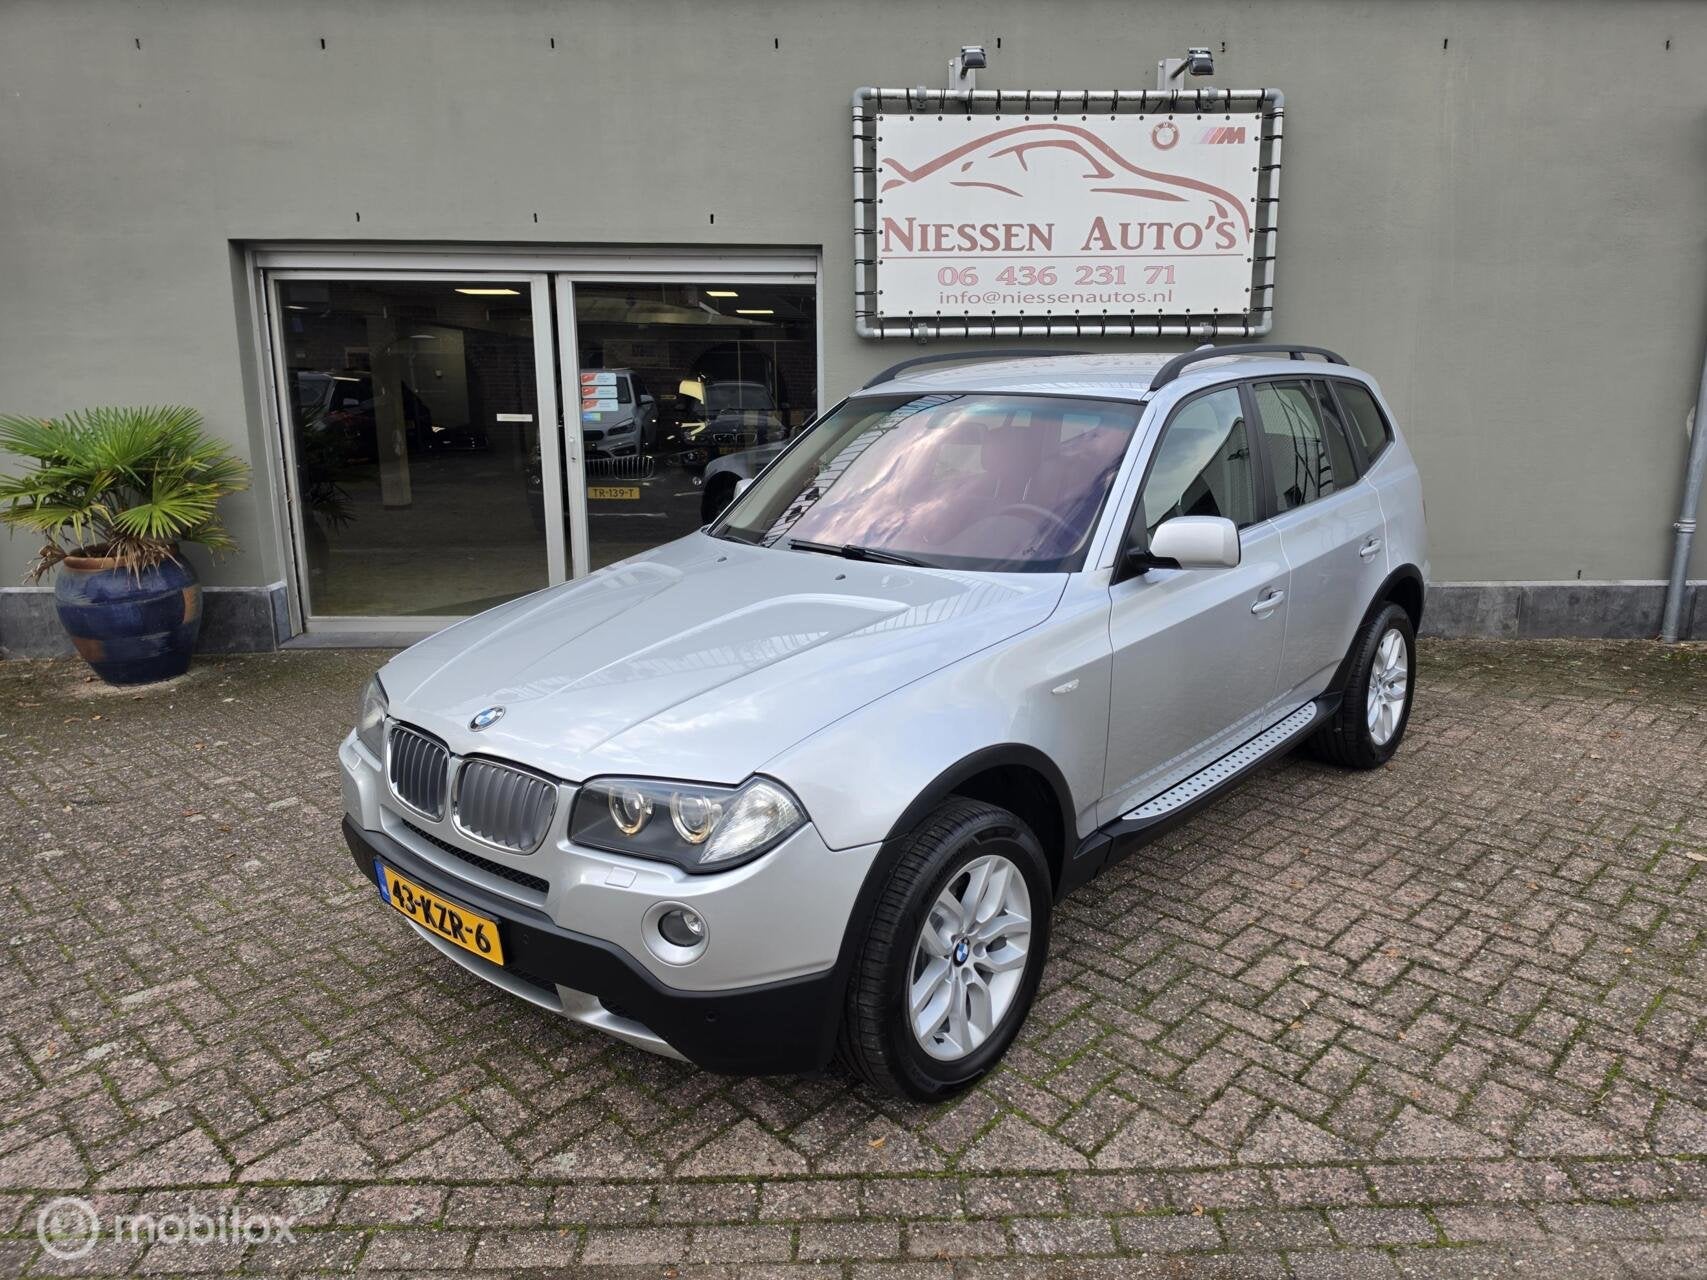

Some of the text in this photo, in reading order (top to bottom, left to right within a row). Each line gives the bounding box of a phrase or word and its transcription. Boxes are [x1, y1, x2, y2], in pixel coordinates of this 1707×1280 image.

[881, 215, 1237, 253] NIESSEN AUTO'S
[937, 264, 1176, 287] 06 436 231 71
[939, 289, 1173, 306] info@niessenautos.nl
[592, 488, 634, 498] TR-139-T
[392, 879, 492, 954] 43-KZR-6
